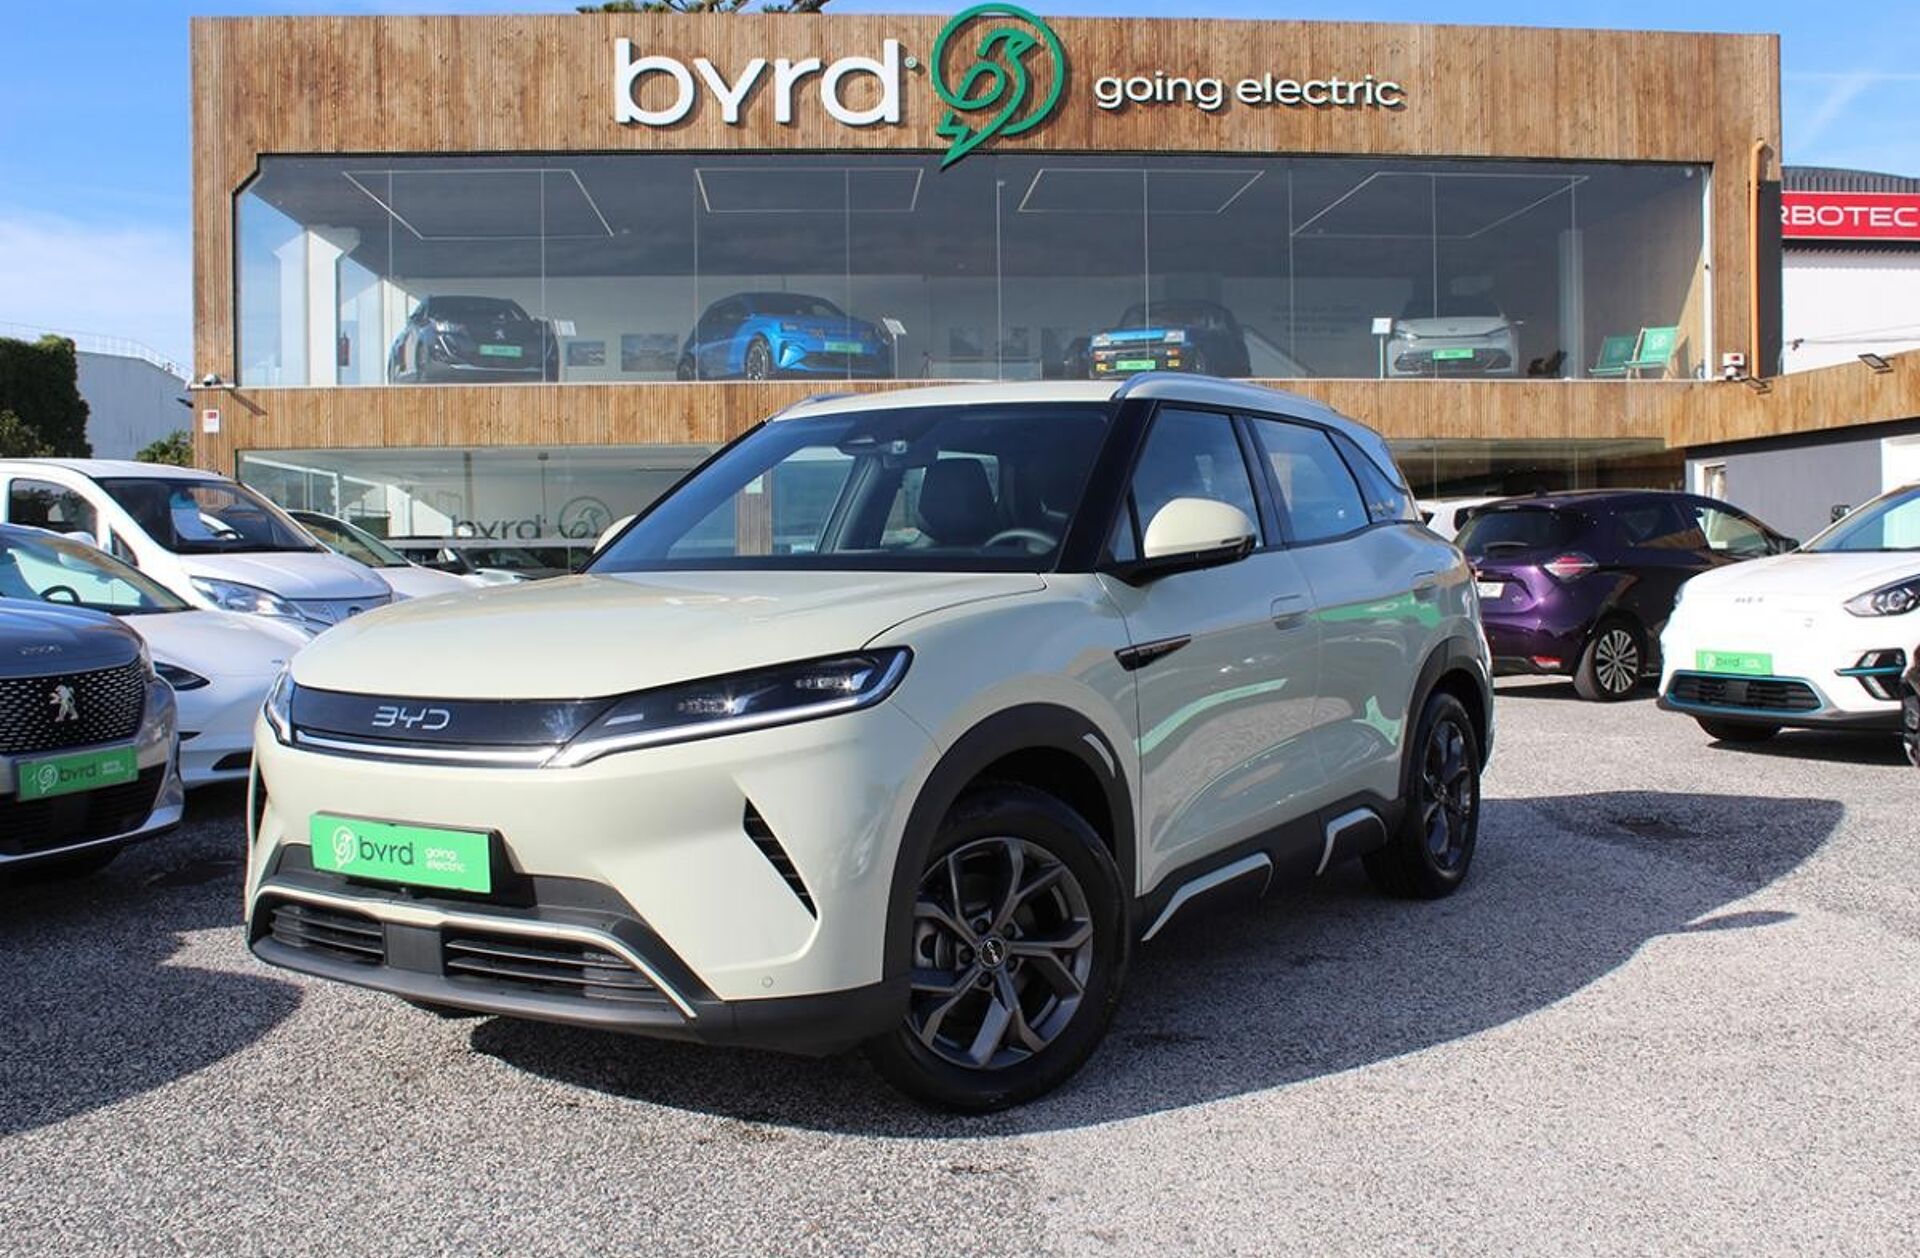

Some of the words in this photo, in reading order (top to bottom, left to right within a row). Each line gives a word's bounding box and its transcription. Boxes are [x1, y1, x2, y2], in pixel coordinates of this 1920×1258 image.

[615, 38, 900, 126] byrd
[1094, 70, 1223, 111] going
[1235, 71, 1402, 106] electric
[372, 706, 450, 730] BYD
[359, 836, 414, 865] byrd
